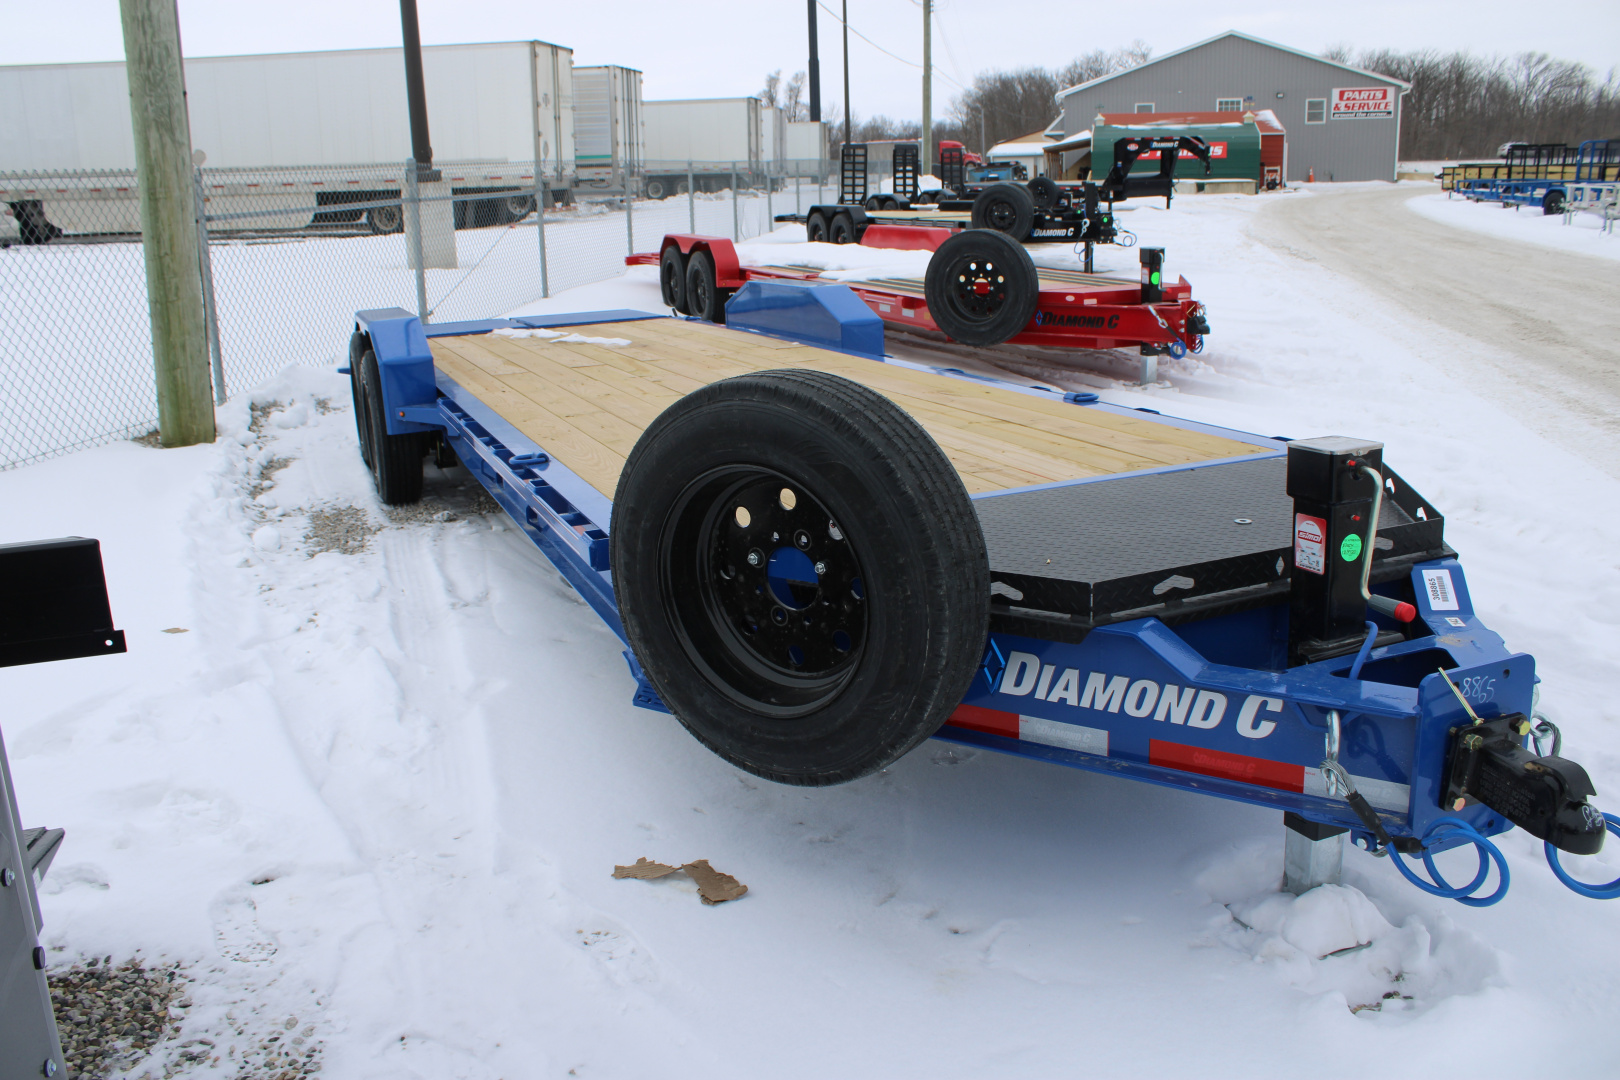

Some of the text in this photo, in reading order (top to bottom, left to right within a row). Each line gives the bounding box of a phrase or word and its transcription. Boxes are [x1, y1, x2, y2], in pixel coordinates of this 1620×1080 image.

[1343, 91, 1384, 101] PARTS
[1334, 102, 1391, 112] & SERVICE
[1033, 227, 1075, 237] DIAMOND C
[1041, 311, 1120, 329] DIAMOND C
[1428, 578, 1441, 601] 308865
[999, 650, 1284, 739] DIAMOND C
[1462, 675, 1496, 703] 8865
